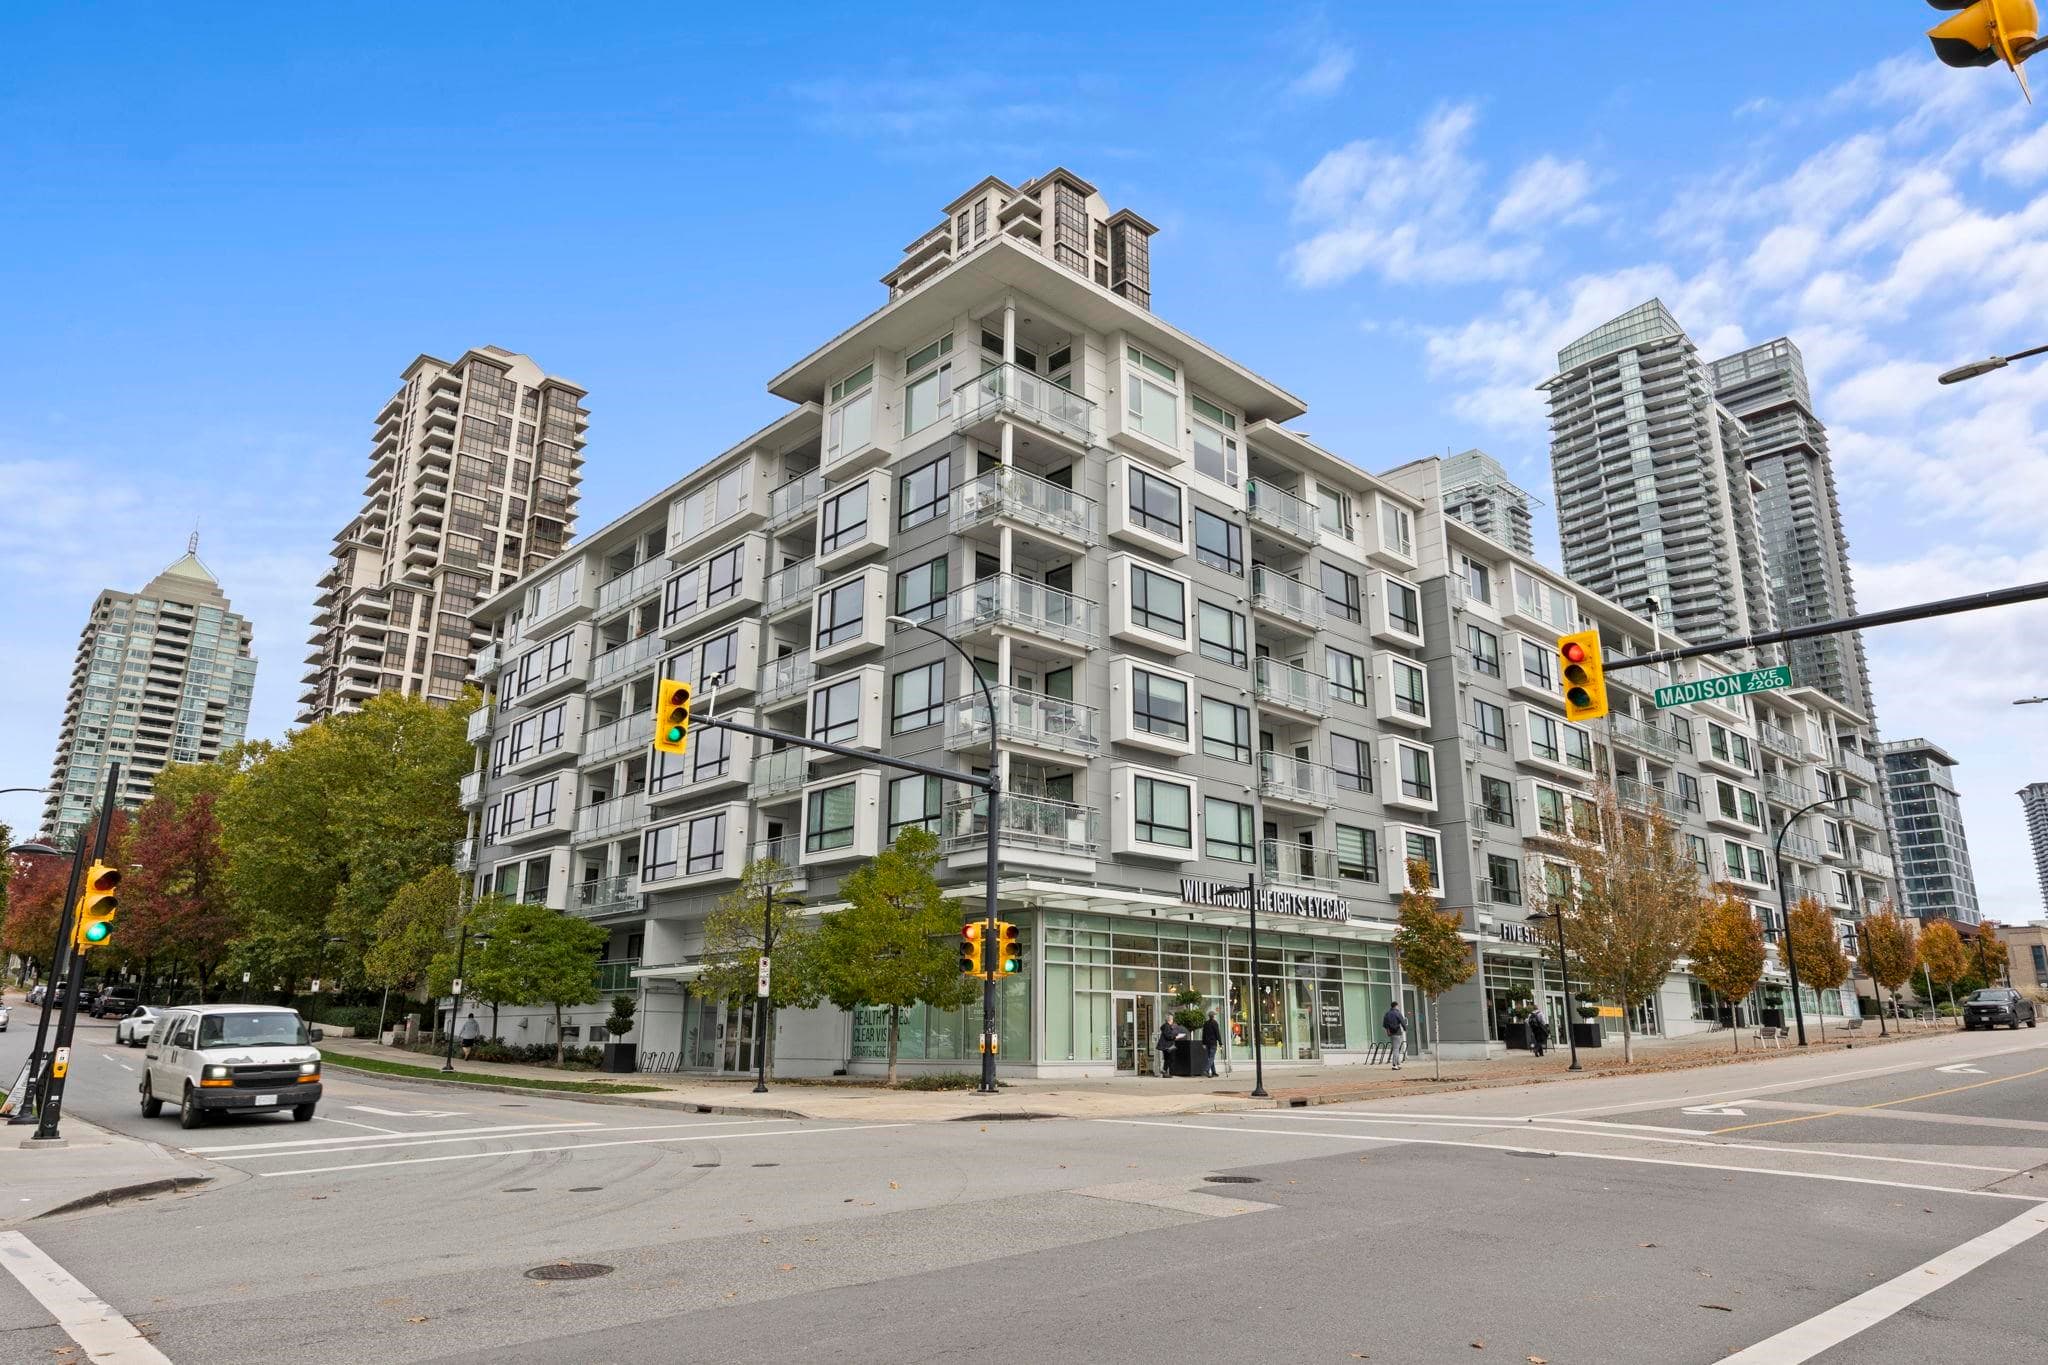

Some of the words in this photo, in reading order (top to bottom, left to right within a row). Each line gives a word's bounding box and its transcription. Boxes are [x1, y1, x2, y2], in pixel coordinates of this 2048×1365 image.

[1660, 676, 1742, 706] MADISON
[1750, 669, 1779, 682] AVE
[1747, 677, 1785, 691] 2200
[1259, 889, 1307, 916] HEIGHTS
[1308, 896, 1351, 921] EYECARE
[1502, 923, 1523, 943] FIVE
[856, 1010, 886, 1025] HEALTHY
[854, 1028, 875, 1042] CLEAR
